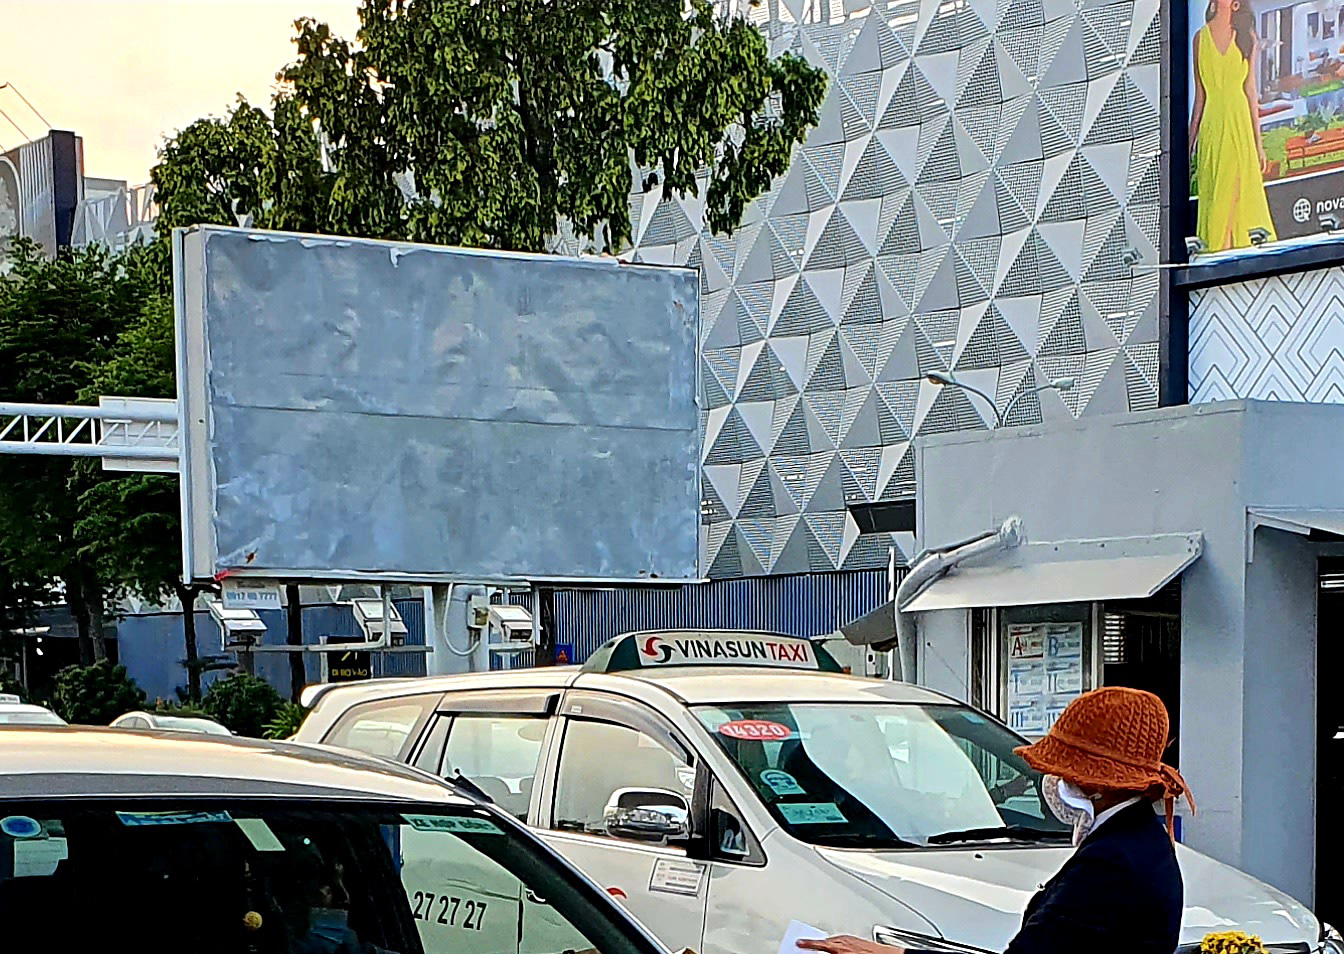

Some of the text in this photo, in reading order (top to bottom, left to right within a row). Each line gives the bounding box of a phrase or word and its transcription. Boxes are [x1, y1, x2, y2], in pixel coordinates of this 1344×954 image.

[723, 724, 785, 736] 14320
[414, 891, 487, 930] 27 27 27
